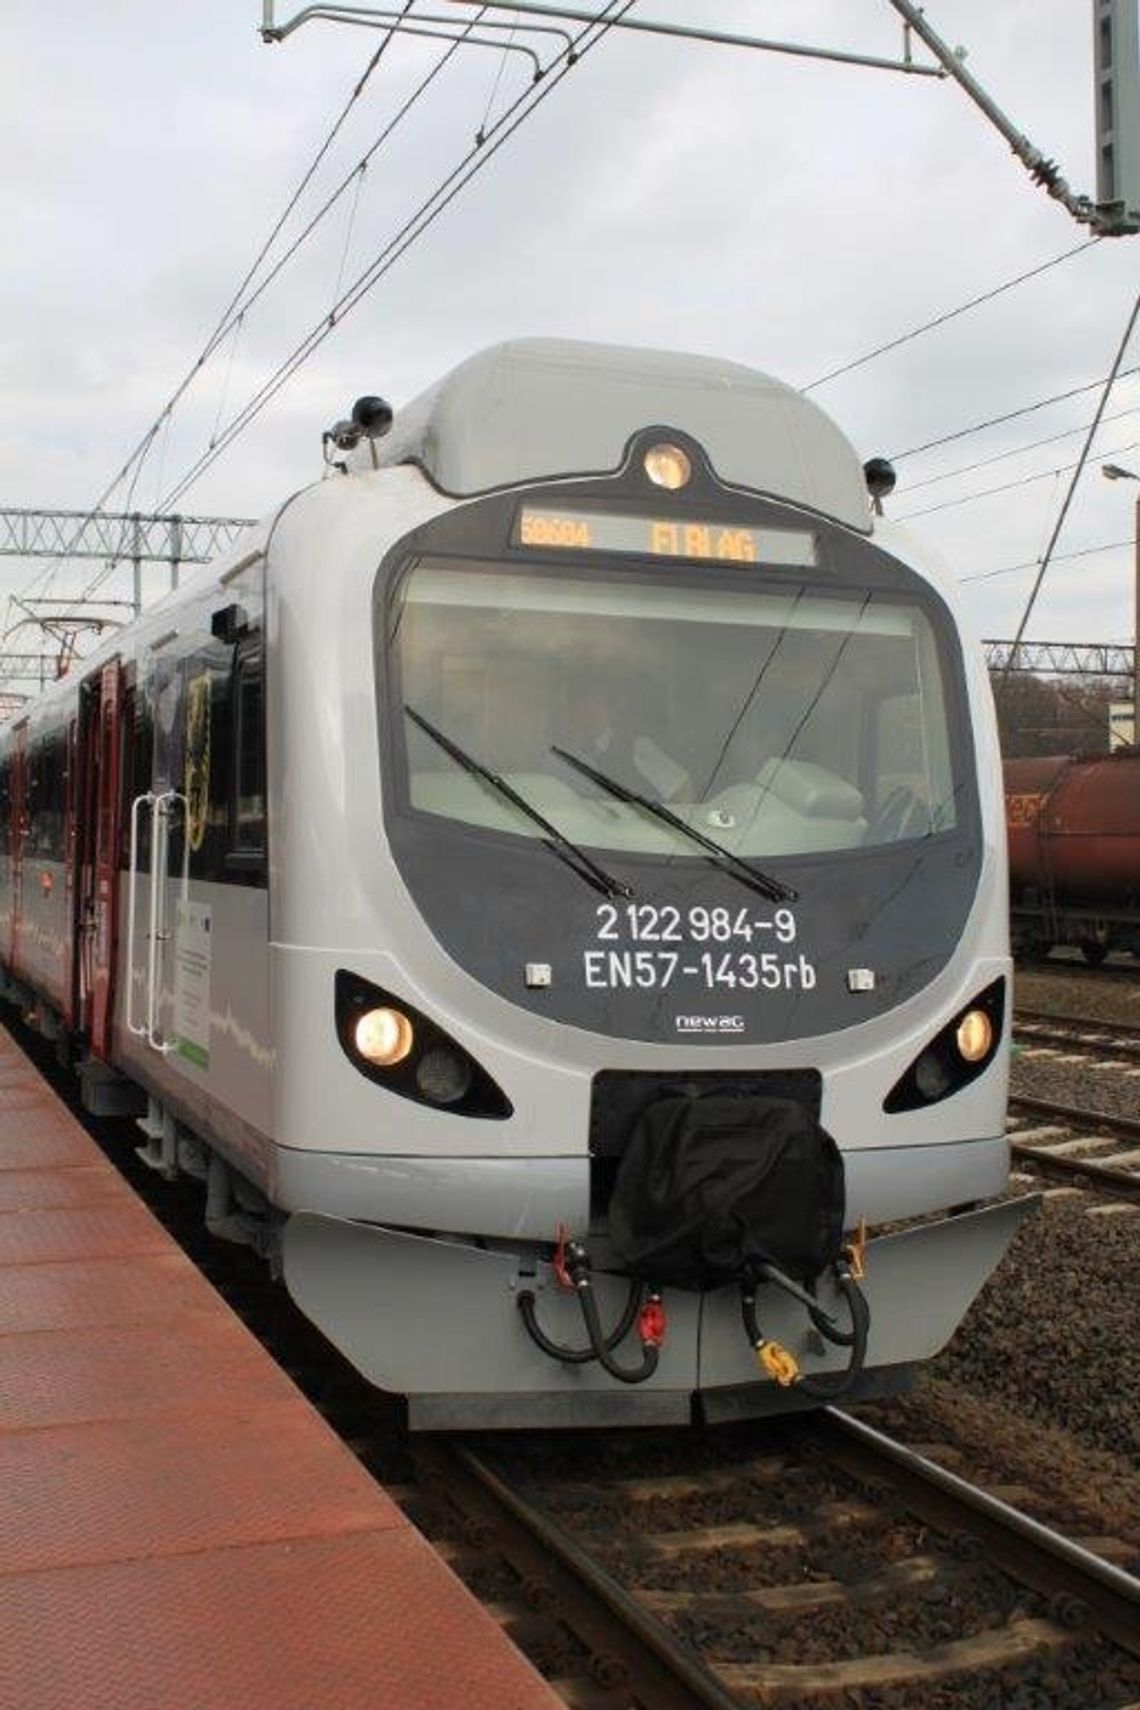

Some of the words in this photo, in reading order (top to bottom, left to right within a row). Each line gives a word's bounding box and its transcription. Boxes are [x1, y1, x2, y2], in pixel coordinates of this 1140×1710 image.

[596, 904, 619, 940] 2
[627, 904, 682, 942] 122
[689, 907, 796, 943] 984-9
[585, 951, 817, 989] EN57-1435rb
